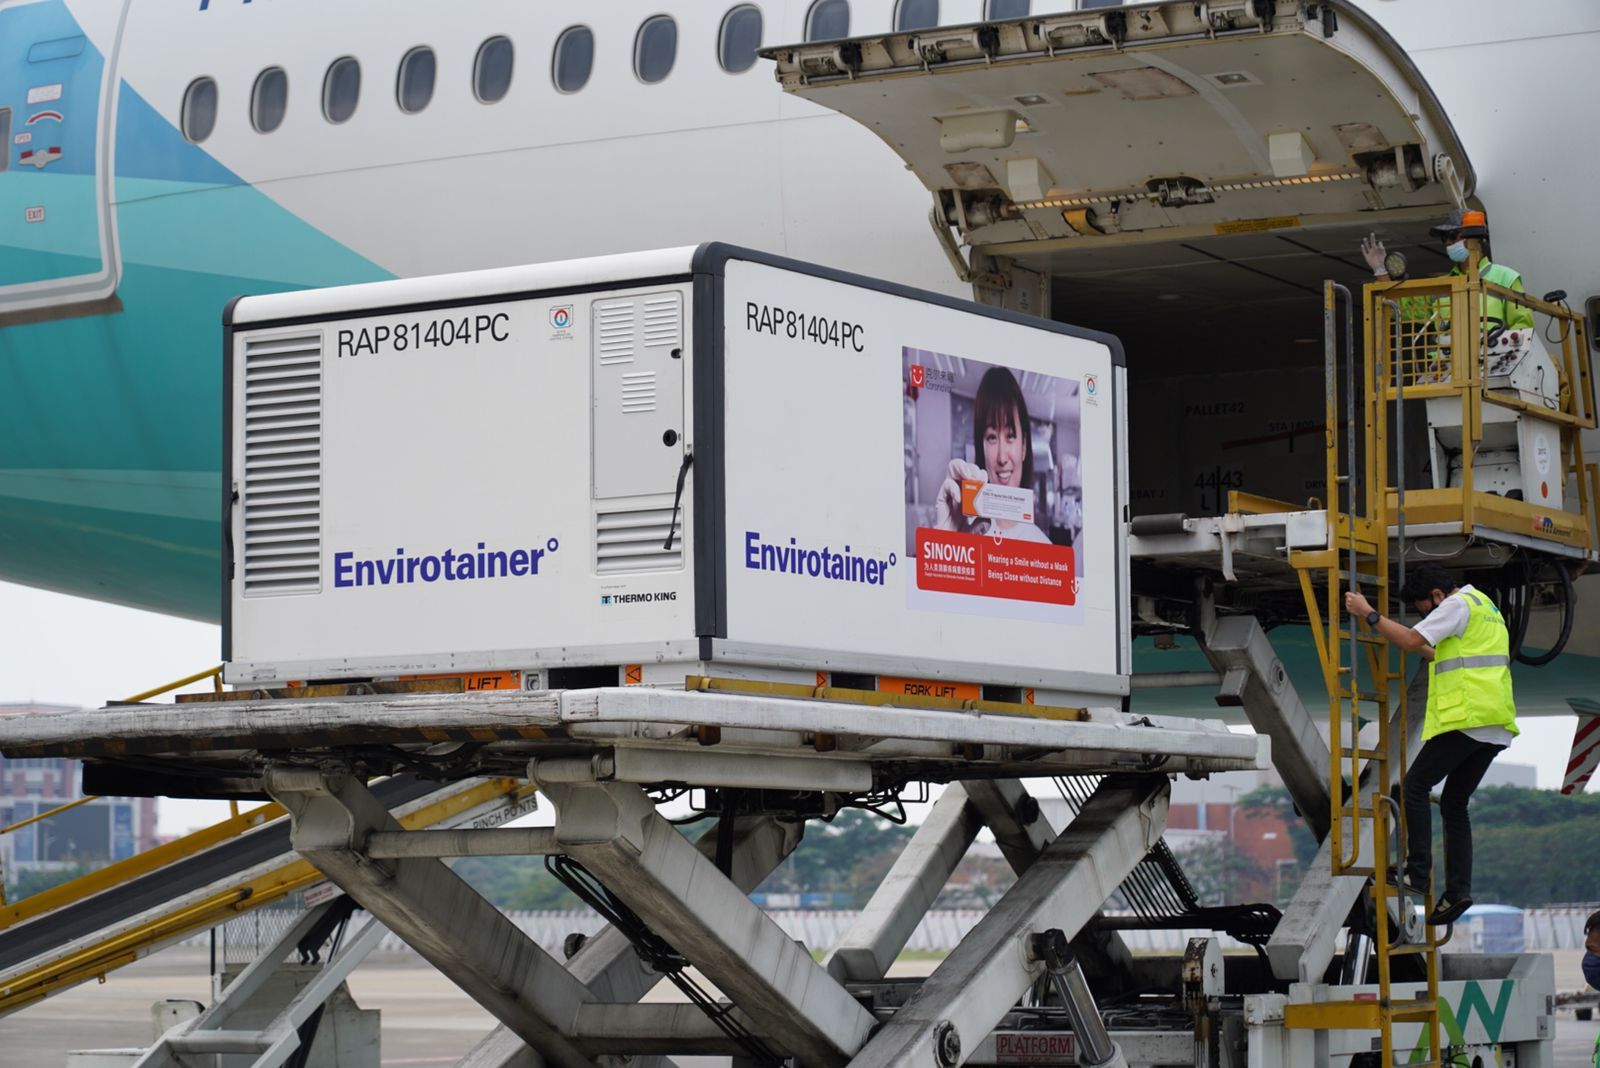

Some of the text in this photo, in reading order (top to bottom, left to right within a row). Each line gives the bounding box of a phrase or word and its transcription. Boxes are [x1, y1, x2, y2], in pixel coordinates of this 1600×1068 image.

[27, 209, 43, 220] EXIT
[1184, 402, 1229, 417] PALLET
[1193, 470, 1243, 489] 44 43
[923, 541, 976, 565] SINOVAC
[987, 553, 1009, 566] Wearing
[1014, 556, 1029, 567] Smile
[1030, 559, 1049, 569] without
[1054, 562, 1068, 571] Mask
[987, 569, 1003, 582] Being
[1003, 571, 1018, 582] Close
[1019, 573, 1039, 584] without
[1039, 575, 1062, 587] Distance
[612, 591, 677, 604] THERMO KING
[467, 677, 503, 690] LIFT
[904, 683, 957, 699] FORK LIFT
[473, 797, 538, 829] PINCH PONTS
[1000, 1037, 1072, 1054] PLATFORM
